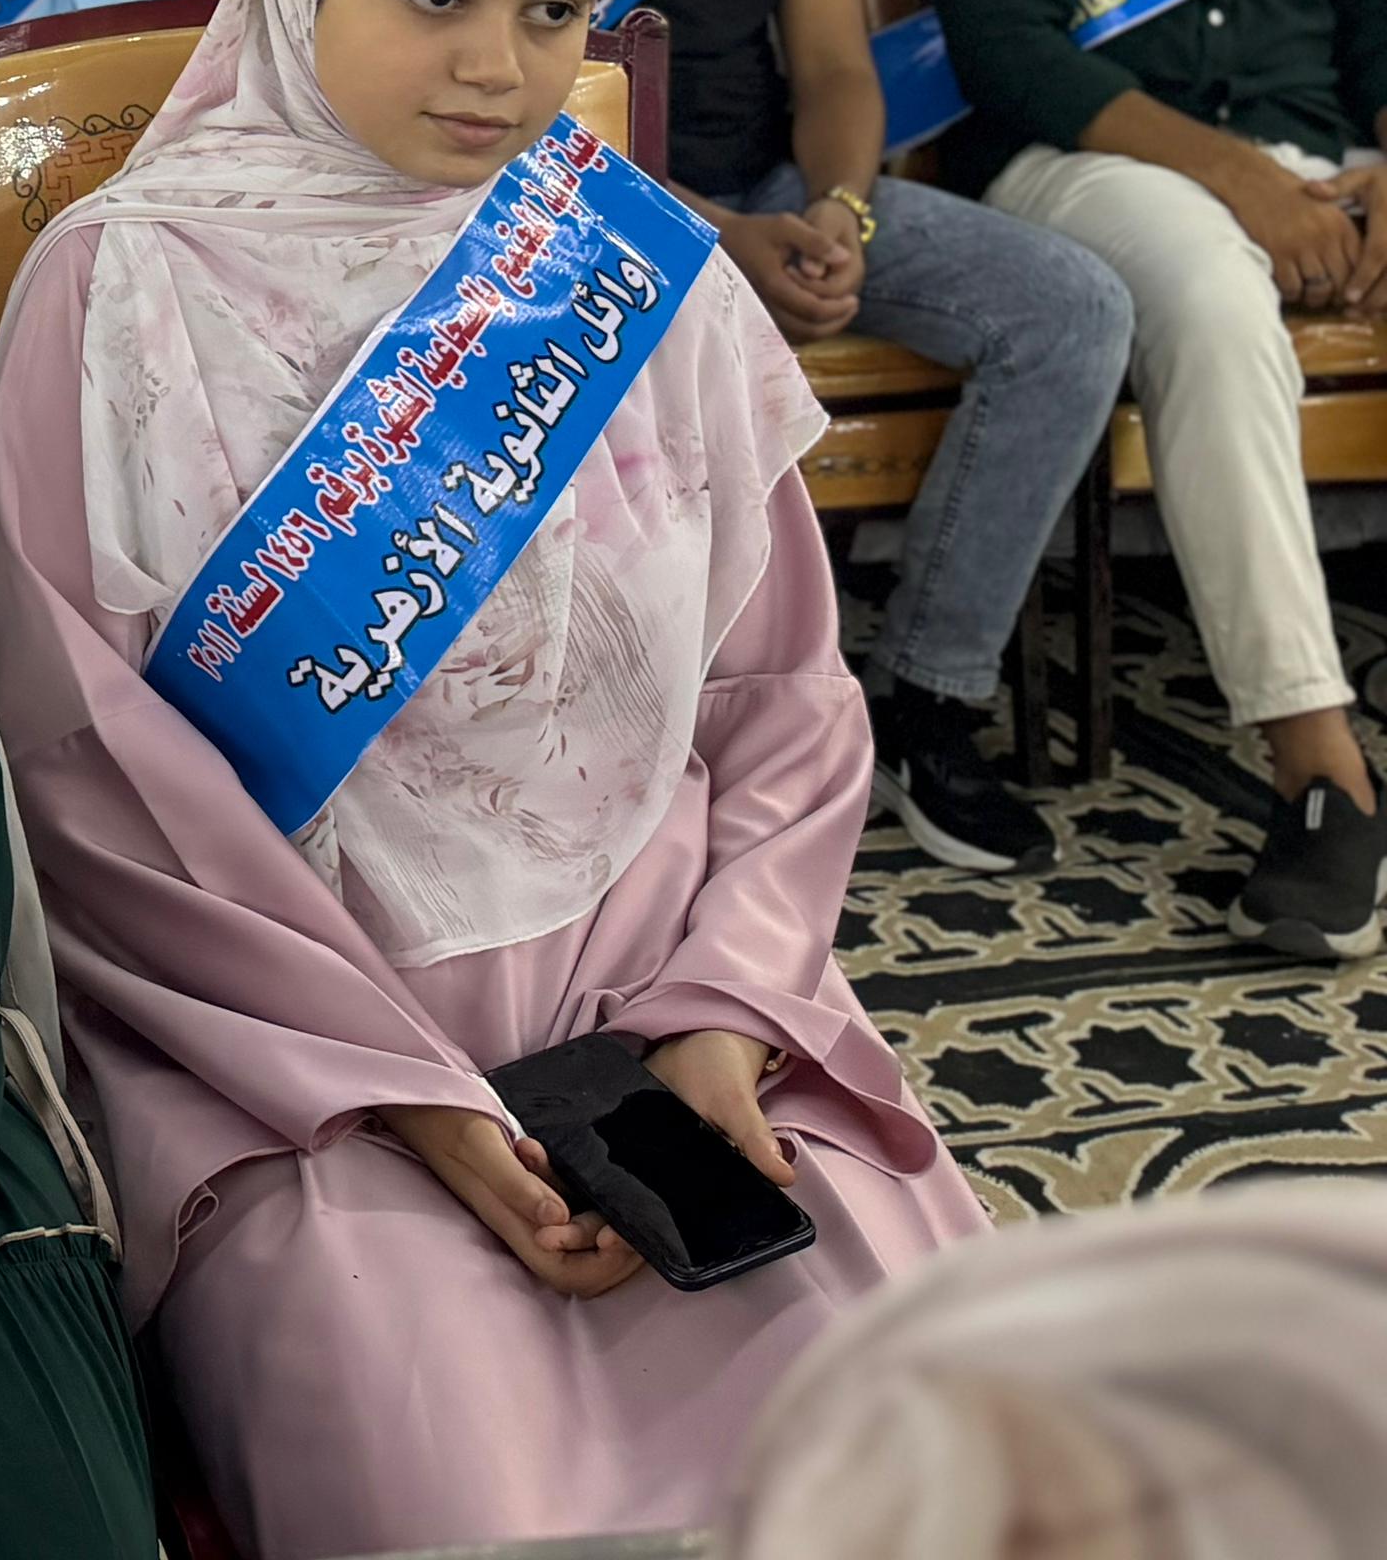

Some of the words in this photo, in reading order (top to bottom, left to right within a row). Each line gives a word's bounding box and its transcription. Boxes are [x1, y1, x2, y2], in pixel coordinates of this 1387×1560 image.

[491, 195, 560, 300] المجتمع
[397, 272, 517, 389] بالسجاعية
[342, 366, 436, 468] المشهرة
[443, 338, 590, 516] الثانوية
[306, 448, 393, 538] برقم
[255, 507, 333, 582] ١٤٥٦
[205, 560, 285, 639] لسنة
[288, 501, 477, 713] الأزهرية
[187, 619, 242, 684] ٢٠١١
